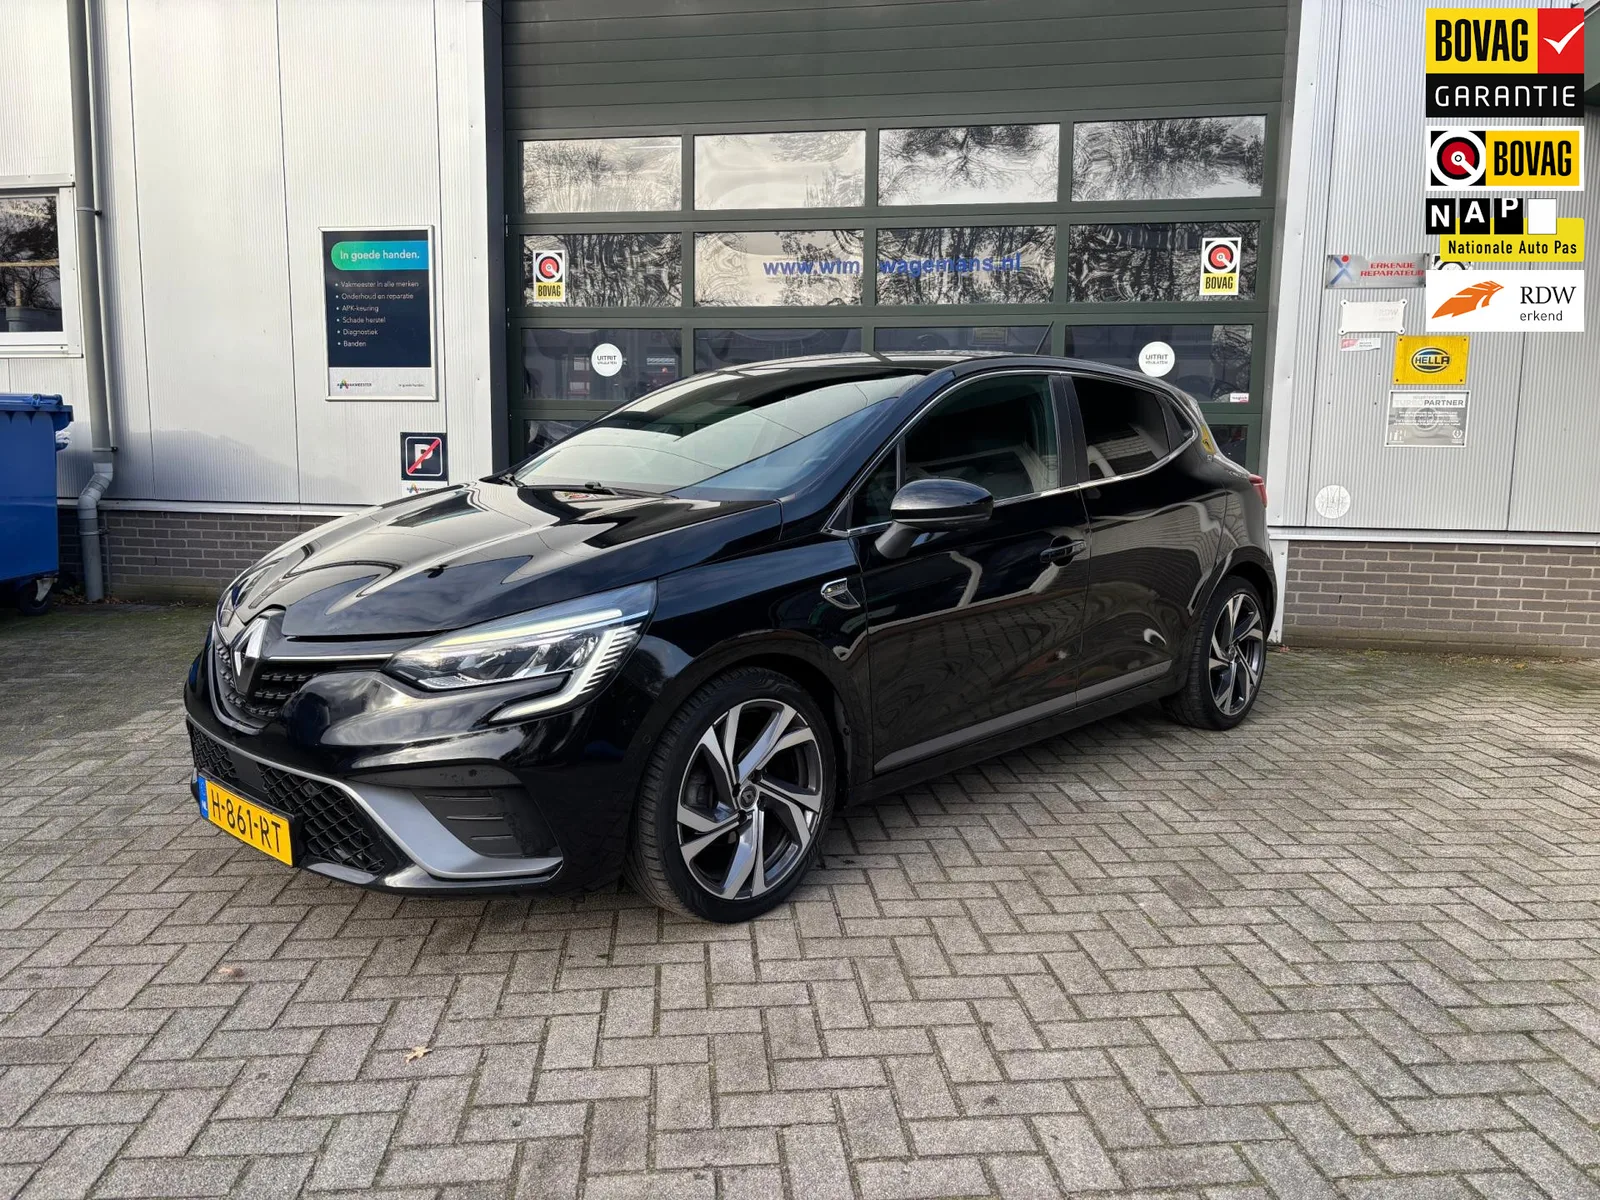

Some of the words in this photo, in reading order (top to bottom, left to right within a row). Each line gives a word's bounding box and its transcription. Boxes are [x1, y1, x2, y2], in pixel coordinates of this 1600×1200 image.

[340, 250, 349, 259] In
[351, 249, 380, 262] goede
[382, 249, 420, 259] handen.
[878, 253, 1022, 278] wagemans.nl
[1360, 269, 1424, 277] REPARATEUR
[1205, 276, 1234, 290] BOVAG
[537, 284, 562, 297] BOVAG
[341, 305, 379, 313] APK-keuring
[342, 316, 365, 324] Schade
[365, 316, 386, 324] herstel
[343, 328, 379, 336] Diagnostiek
[1415, 355, 1450, 365] HELLA
[210, 788, 281, 853] H-861-RT
